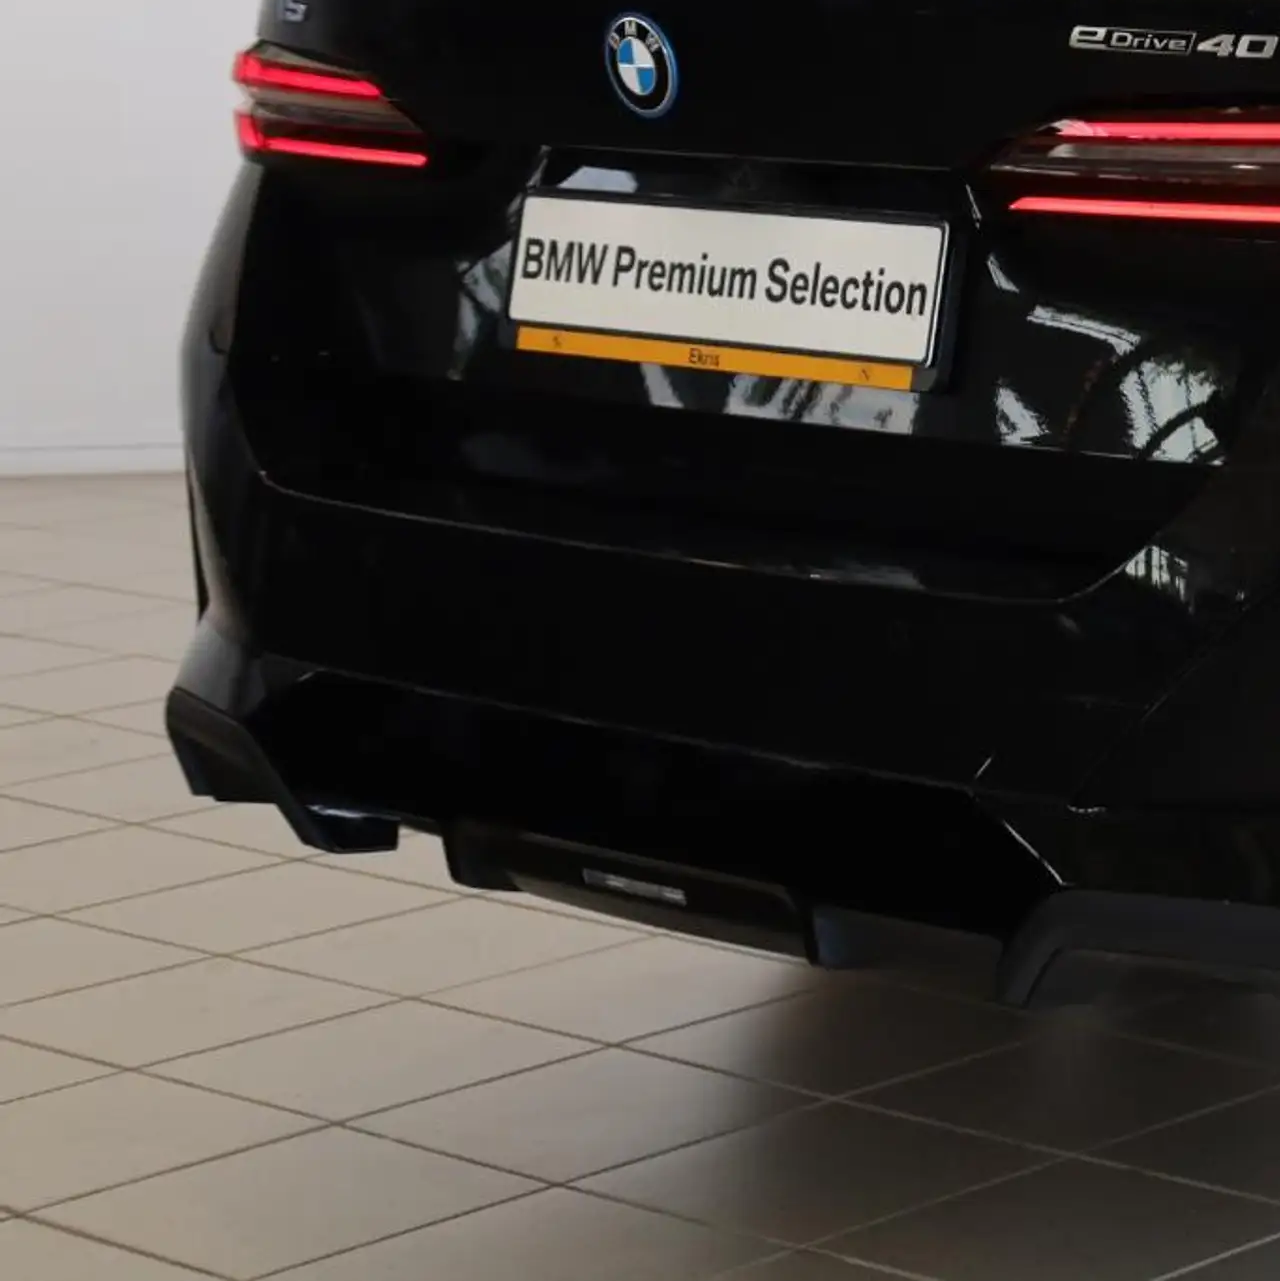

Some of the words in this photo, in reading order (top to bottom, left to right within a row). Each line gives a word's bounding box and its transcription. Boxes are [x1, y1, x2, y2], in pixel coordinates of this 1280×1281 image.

[608, 19, 662, 53] BMW
[521, 237, 609, 288] BMW
[612, 245, 758, 300] Premium
[765, 257, 928, 317] Selection
